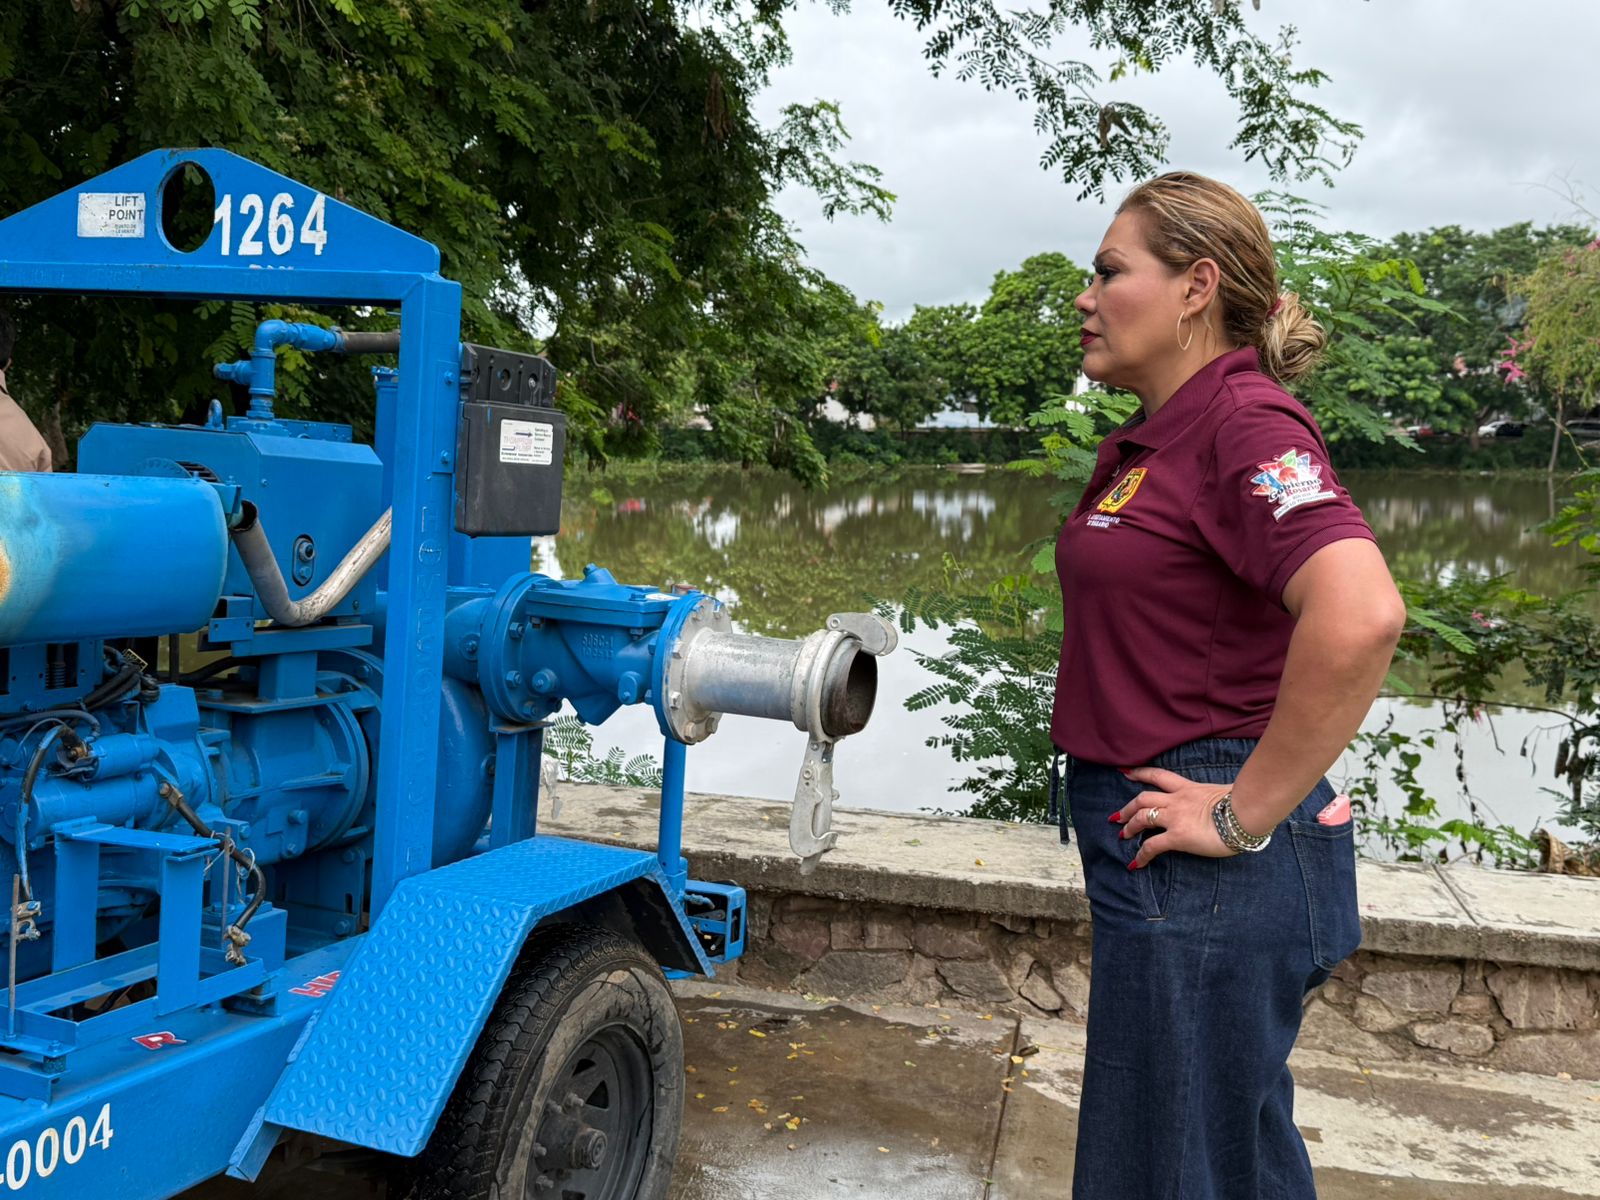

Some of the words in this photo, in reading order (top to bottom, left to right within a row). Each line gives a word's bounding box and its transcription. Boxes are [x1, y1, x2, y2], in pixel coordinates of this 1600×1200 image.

[115, 195, 139, 207] LIFT
[109, 209, 143, 220] POINT
[214, 192, 327, 256] 1264
[1269, 478, 1320, 501] Gobierno
[131, 1030, 187, 1051] R
